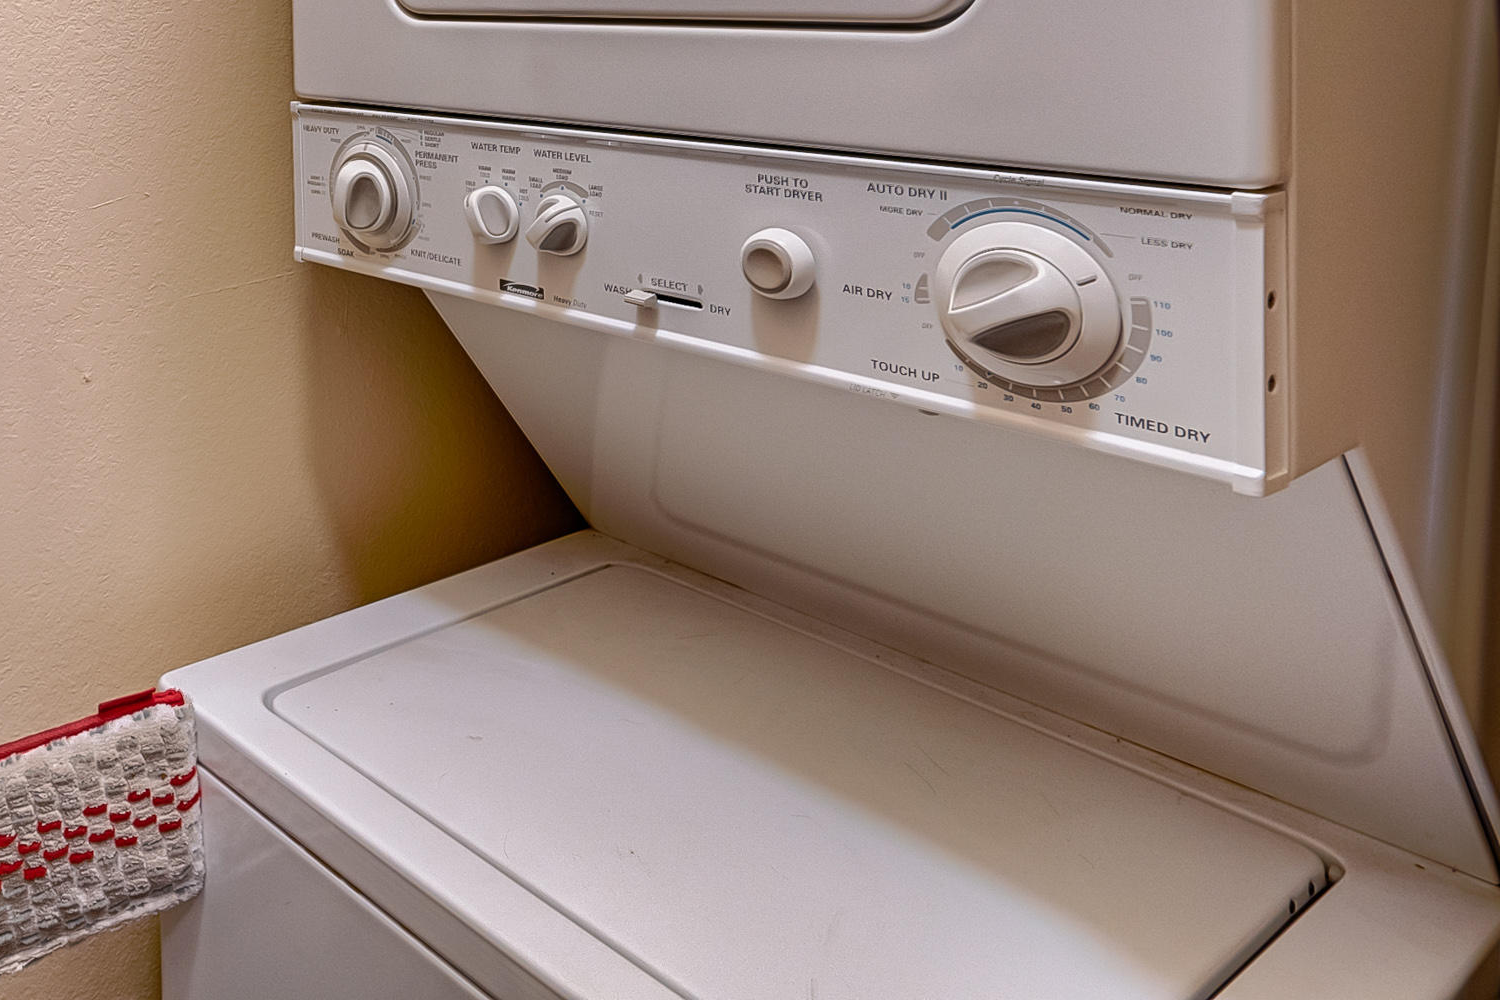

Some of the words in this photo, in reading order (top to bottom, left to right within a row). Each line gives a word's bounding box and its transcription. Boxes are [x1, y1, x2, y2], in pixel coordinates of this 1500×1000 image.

[303, 124, 323, 133] HEAVY
[324, 126, 339, 135] DUTY
[471, 141, 498, 152] WATER
[499, 144, 521, 155] TEMP
[415, 150, 459, 164] PERMANENT
[533, 148, 562, 161] WATER
[564, 152, 592, 164] LEVEL
[415, 159, 438, 169] PRESS
[757, 173, 789, 187] PUSH
[793, 177, 809, 189] TO
[745, 184, 781, 197] START
[784, 188, 823, 202] DRYER
[867, 182, 904, 196] AUTO
[908, 187, 935, 200] DRY
[940, 190, 948, 201] II
[879, 205, 903, 215] MORE
[905, 208, 924, 216] DRY
[1119, 206, 1168, 218] NORMAL
[1170, 211, 1193, 220] DRY
[311, 232, 340, 244] PREWASH
[1140, 237, 1169, 248] LESS
[1170, 241, 1193, 250] DRY
[337, 248, 354, 257] SOAK
[410, 248, 462, 267] KNIT/DELICATE
[505, 284, 544, 298] Kenmore
[603, 283, 632, 295] WASH
[651, 278, 688, 292] SELECT
[842, 284, 863, 296] AIR
[866, 288, 893, 301] DRY
[553, 296, 572, 306] Heavy
[572, 299, 587, 309] Duty
[1153, 301, 1171, 310] 110
[709, 304, 731, 316] DRY
[1155, 328, 1173, 338] 100
[1150, 354, 1162, 363] 90
[870, 359, 917, 378] TOUCH
[921, 370, 940, 382] UP
[954, 364, 964, 372] 10
[861, 385, 886, 398] LATCH
[977, 381, 988, 390] 20
[1003, 394, 1014, 402] 30
[1114, 393, 1126, 403] 70
[1031, 402, 1042, 411] 40
[1060, 405, 1072, 414] 50
[1088, 402, 1100, 412] 60
[1114, 412, 1169, 435] TIMED
[1174, 425, 1212, 444] DRY
